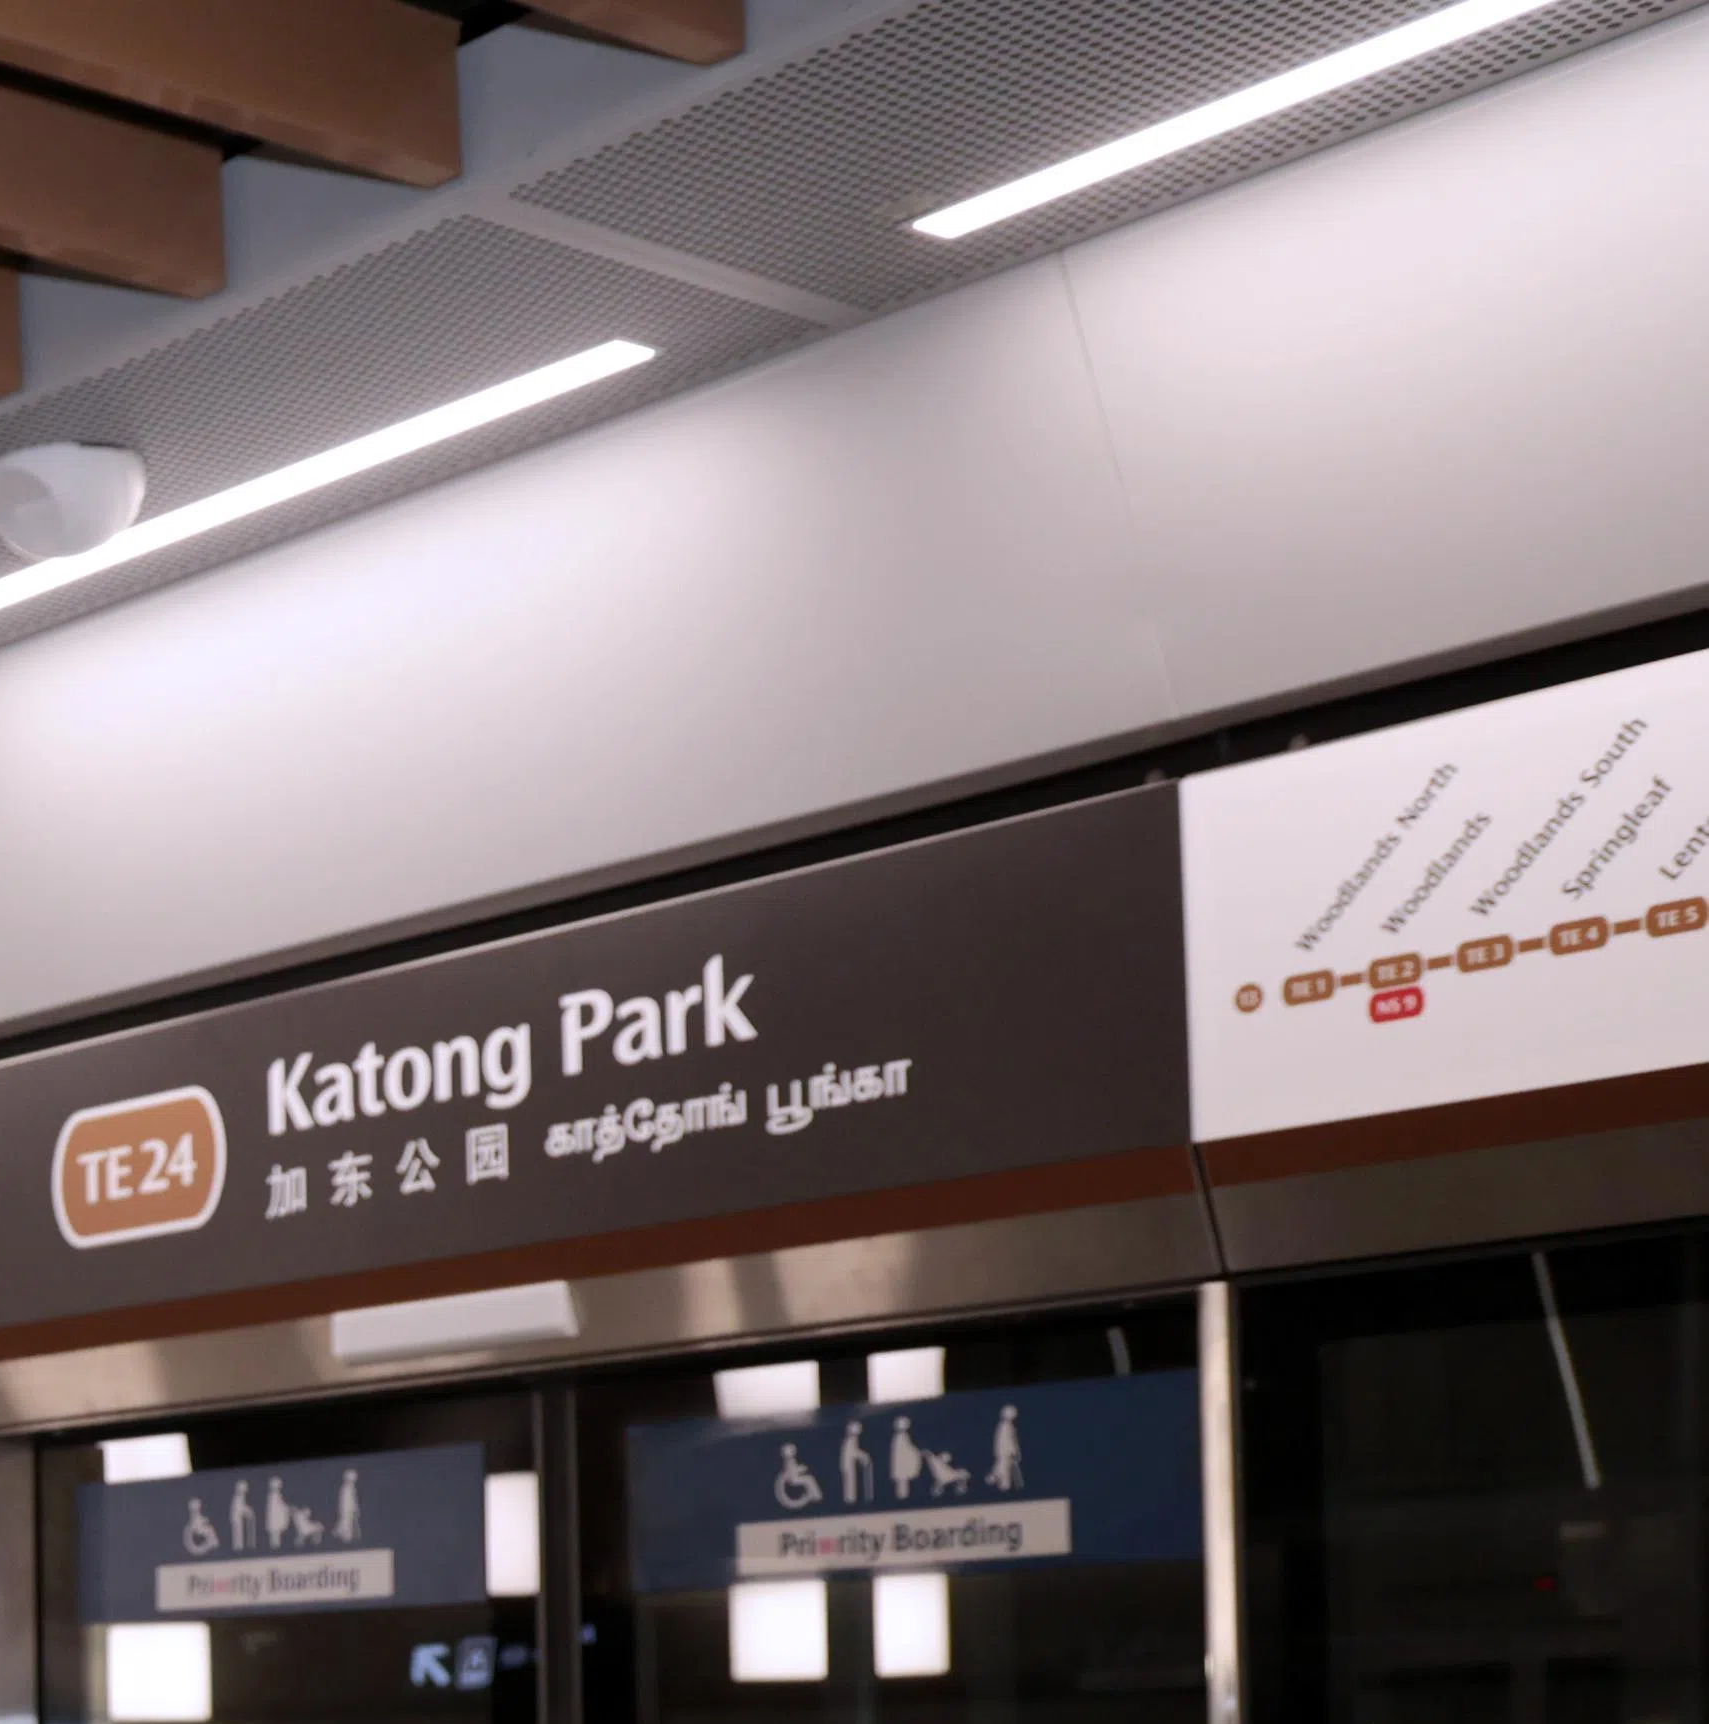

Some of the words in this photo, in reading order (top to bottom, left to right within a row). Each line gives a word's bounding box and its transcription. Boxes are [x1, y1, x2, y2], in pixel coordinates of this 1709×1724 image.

[1295, 833, 1401, 951] Woodlands
[1395, 763, 1458, 829] North
[1380, 813, 1492, 934] Woodlands
[1469, 791, 1585, 915] Woodlands
[1580, 718, 1648, 788] South
[1560, 775, 1673, 900] Springleaf
[1659, 815, 1709, 880] Lent
[267, 1022, 533, 1137] Katong
[558, 953, 759, 1077] Park
[267, 1563, 360, 1594] Boarding
[893, 1518, 1023, 1552] Boarding
